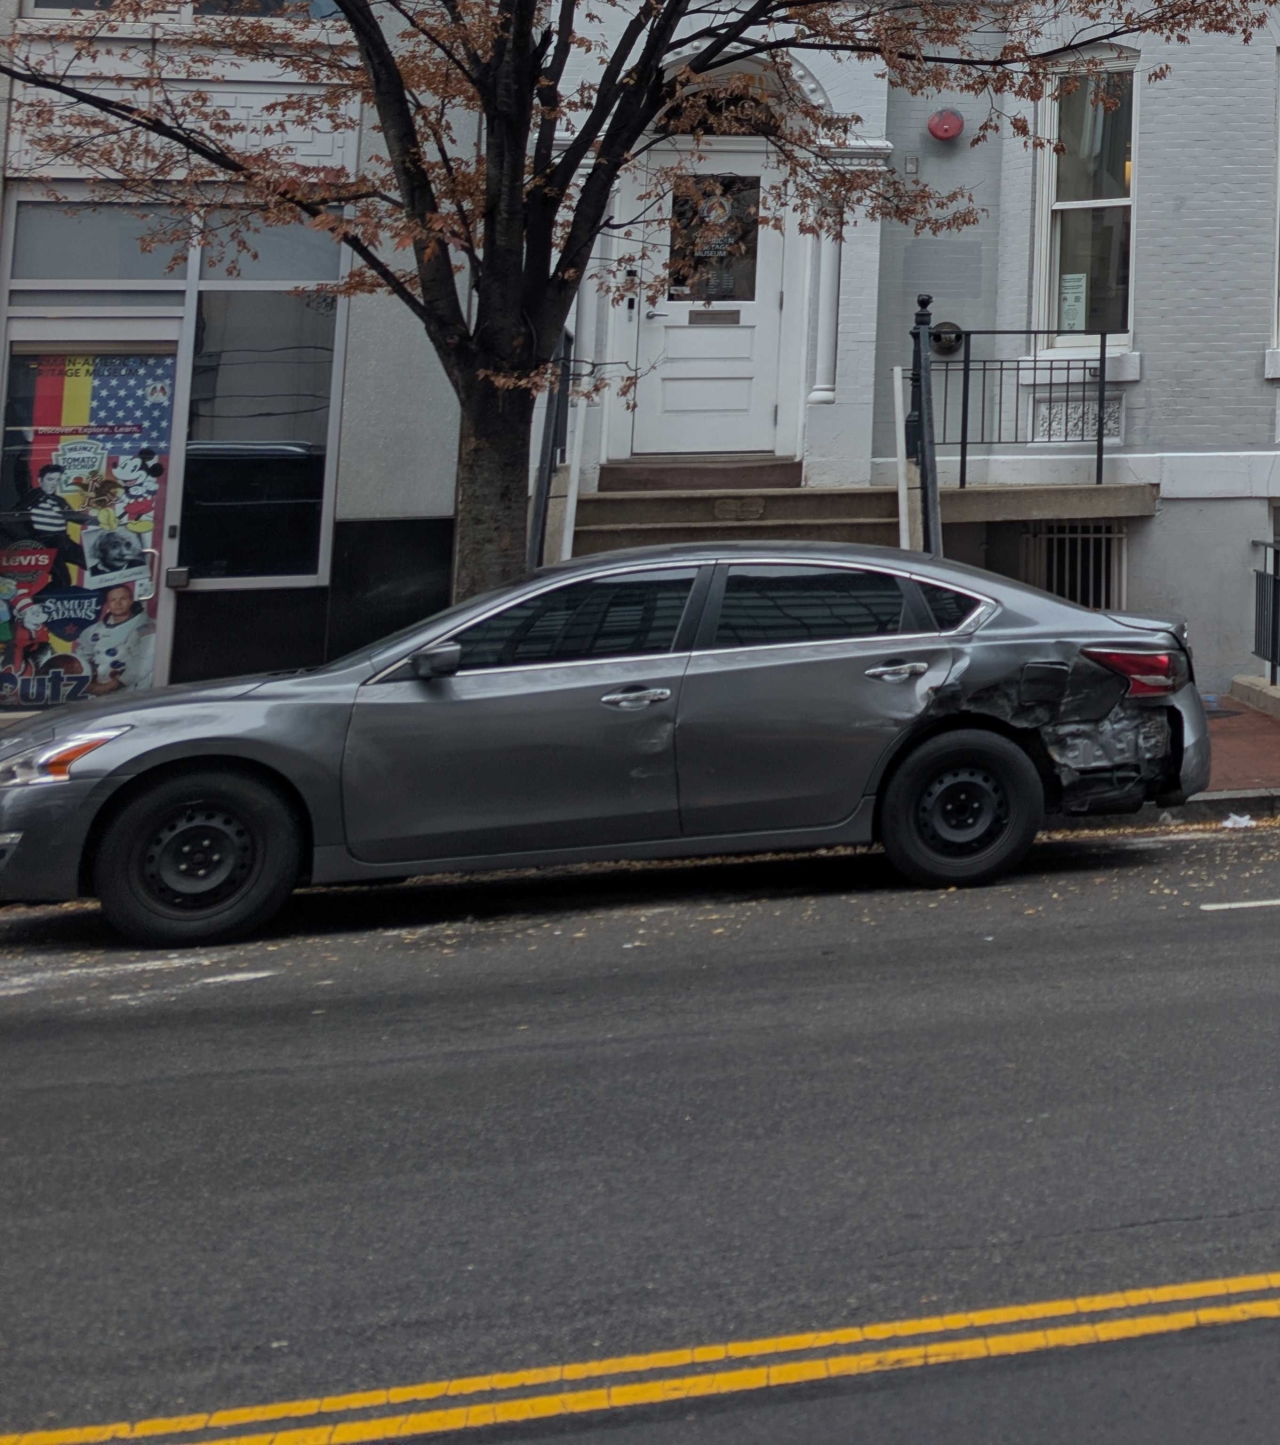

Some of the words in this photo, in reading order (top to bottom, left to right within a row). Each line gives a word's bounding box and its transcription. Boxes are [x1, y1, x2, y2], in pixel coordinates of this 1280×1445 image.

[61, 456, 98, 465] TOMATO
[44, 597, 101, 612] SAMUEL
[47, 607, 96, 623] ADAMS
